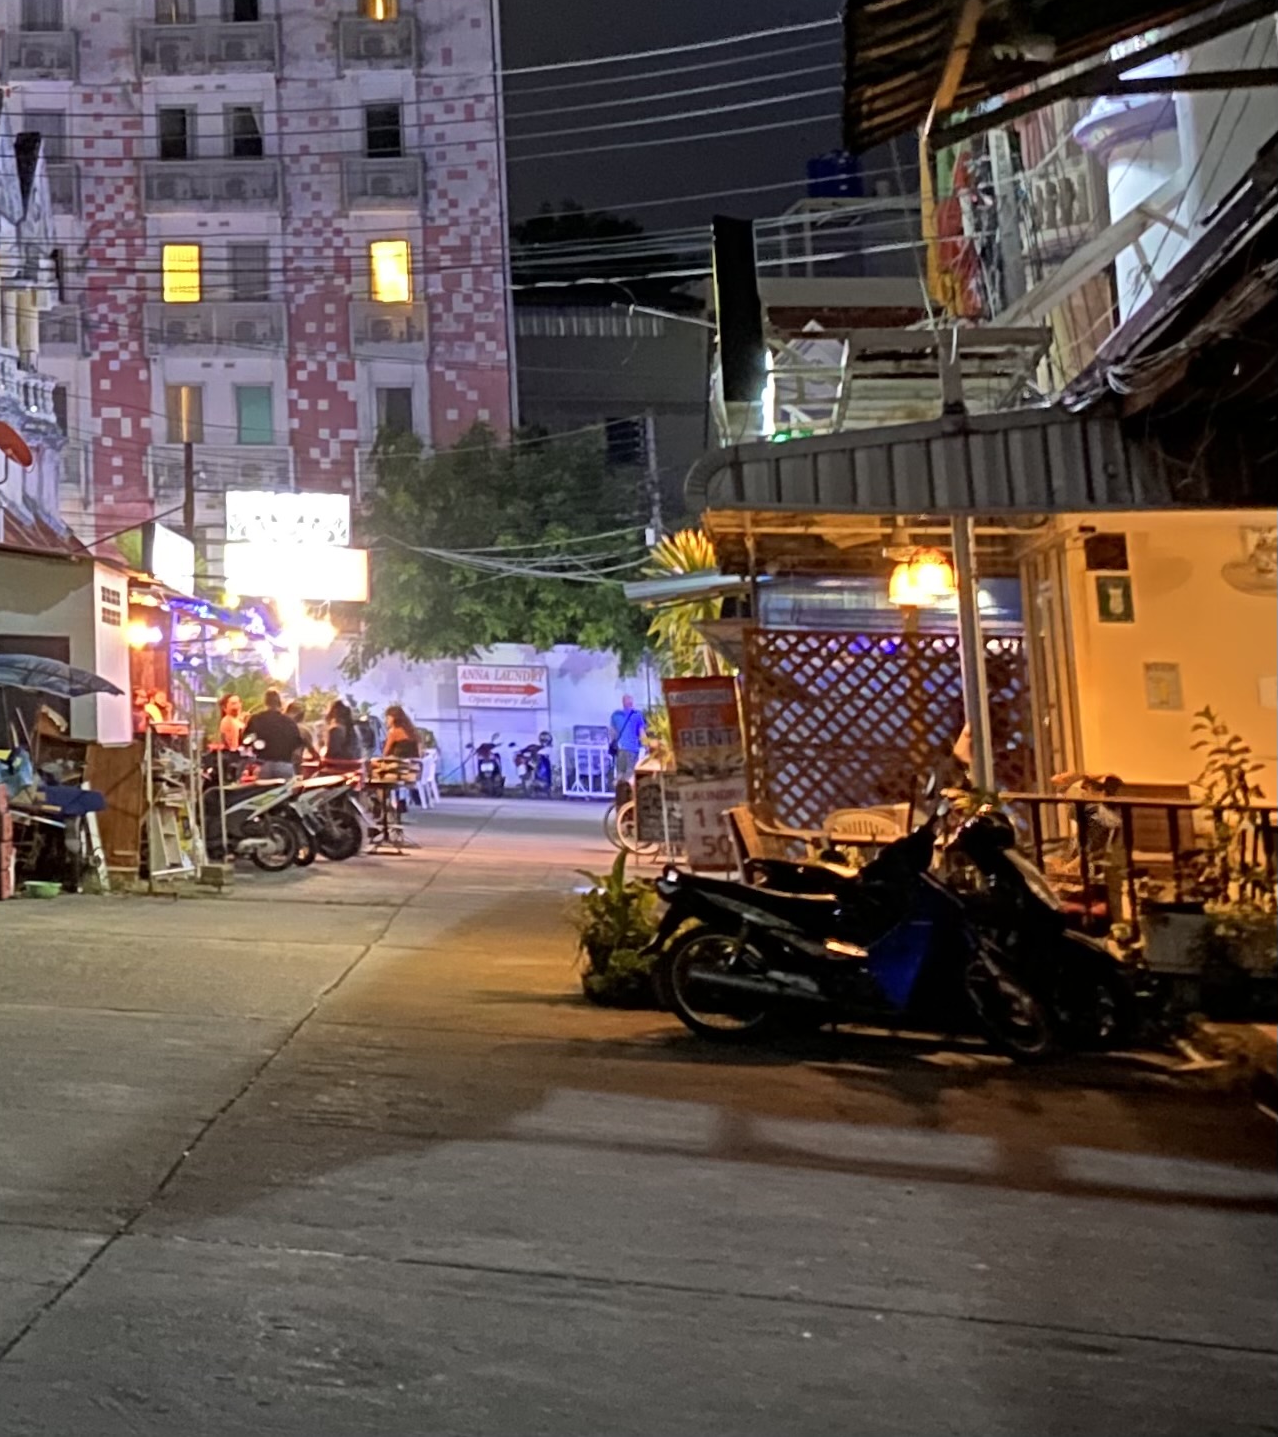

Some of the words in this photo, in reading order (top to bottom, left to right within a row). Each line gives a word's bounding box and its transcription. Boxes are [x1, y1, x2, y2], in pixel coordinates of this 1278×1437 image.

[461, 669, 490, 680] ANNA
[494, 668, 544, 682] LAUNDRY
[469, 695, 492, 706] Open
[680, 728, 734, 747] RENT
